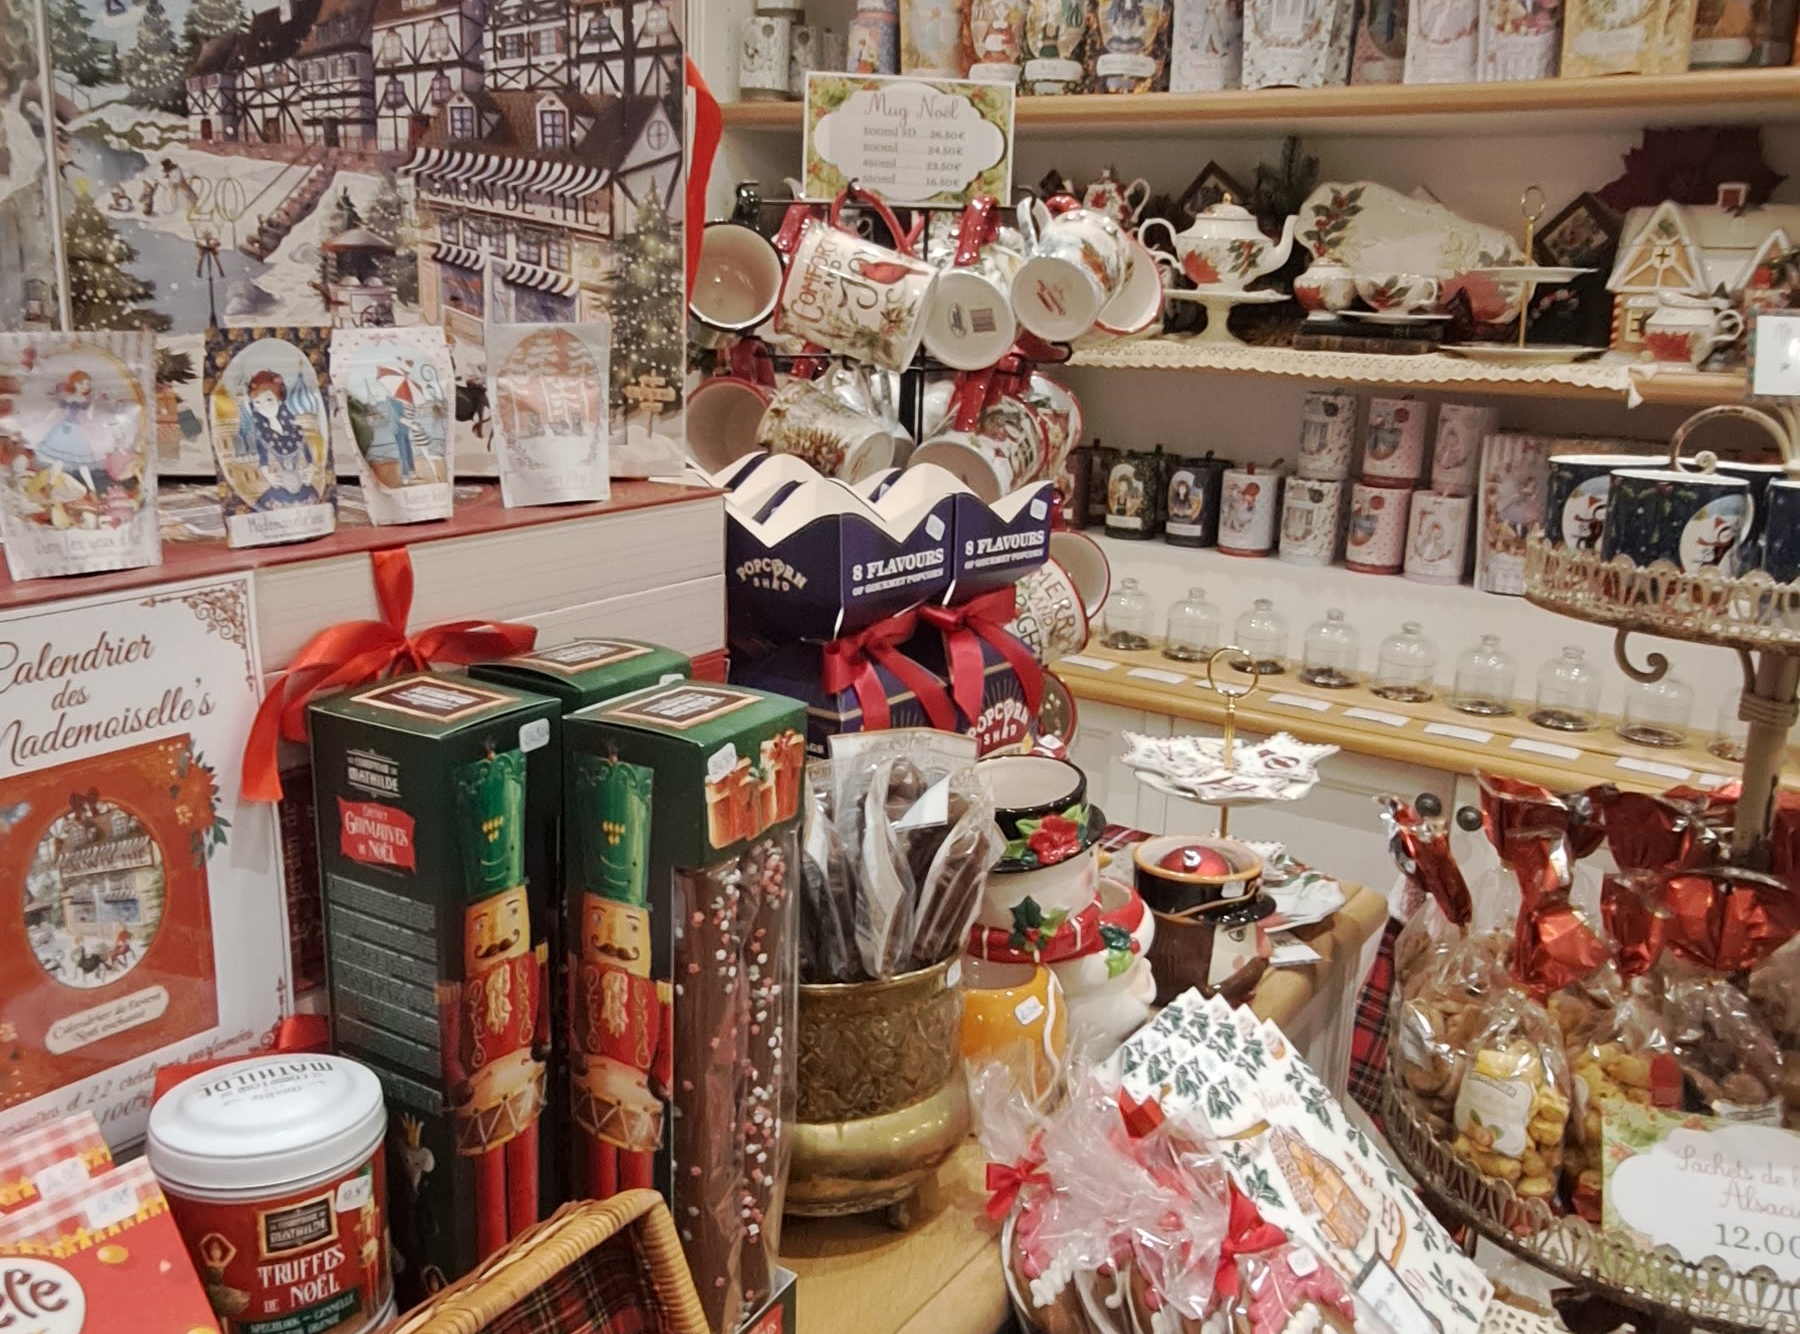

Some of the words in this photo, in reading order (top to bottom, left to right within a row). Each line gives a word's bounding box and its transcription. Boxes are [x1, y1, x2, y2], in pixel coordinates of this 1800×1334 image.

[864, 93, 909, 127] Mug
[917, 94, 959, 119] Noël
[186, 175, 247, 224] 20
[504, 183, 536, 216] DE
[965, 540, 974, 556] 8
[976, 530, 1045, 555] FLAVOURS
[852, 563, 863, 582] 8
[866, 548, 945, 581] FLAVOURS
[51, 679, 90, 711] des
[348, 766, 399, 792] MATHILDE
[367, 839, 398, 865] NOËL
[1675, 1144, 1754, 1181] Sachets
[1761, 1162, 1787, 1187] de
[257, 1243, 346, 1289] TRUFFES
[290, 1272, 341, 1308] NOËL
